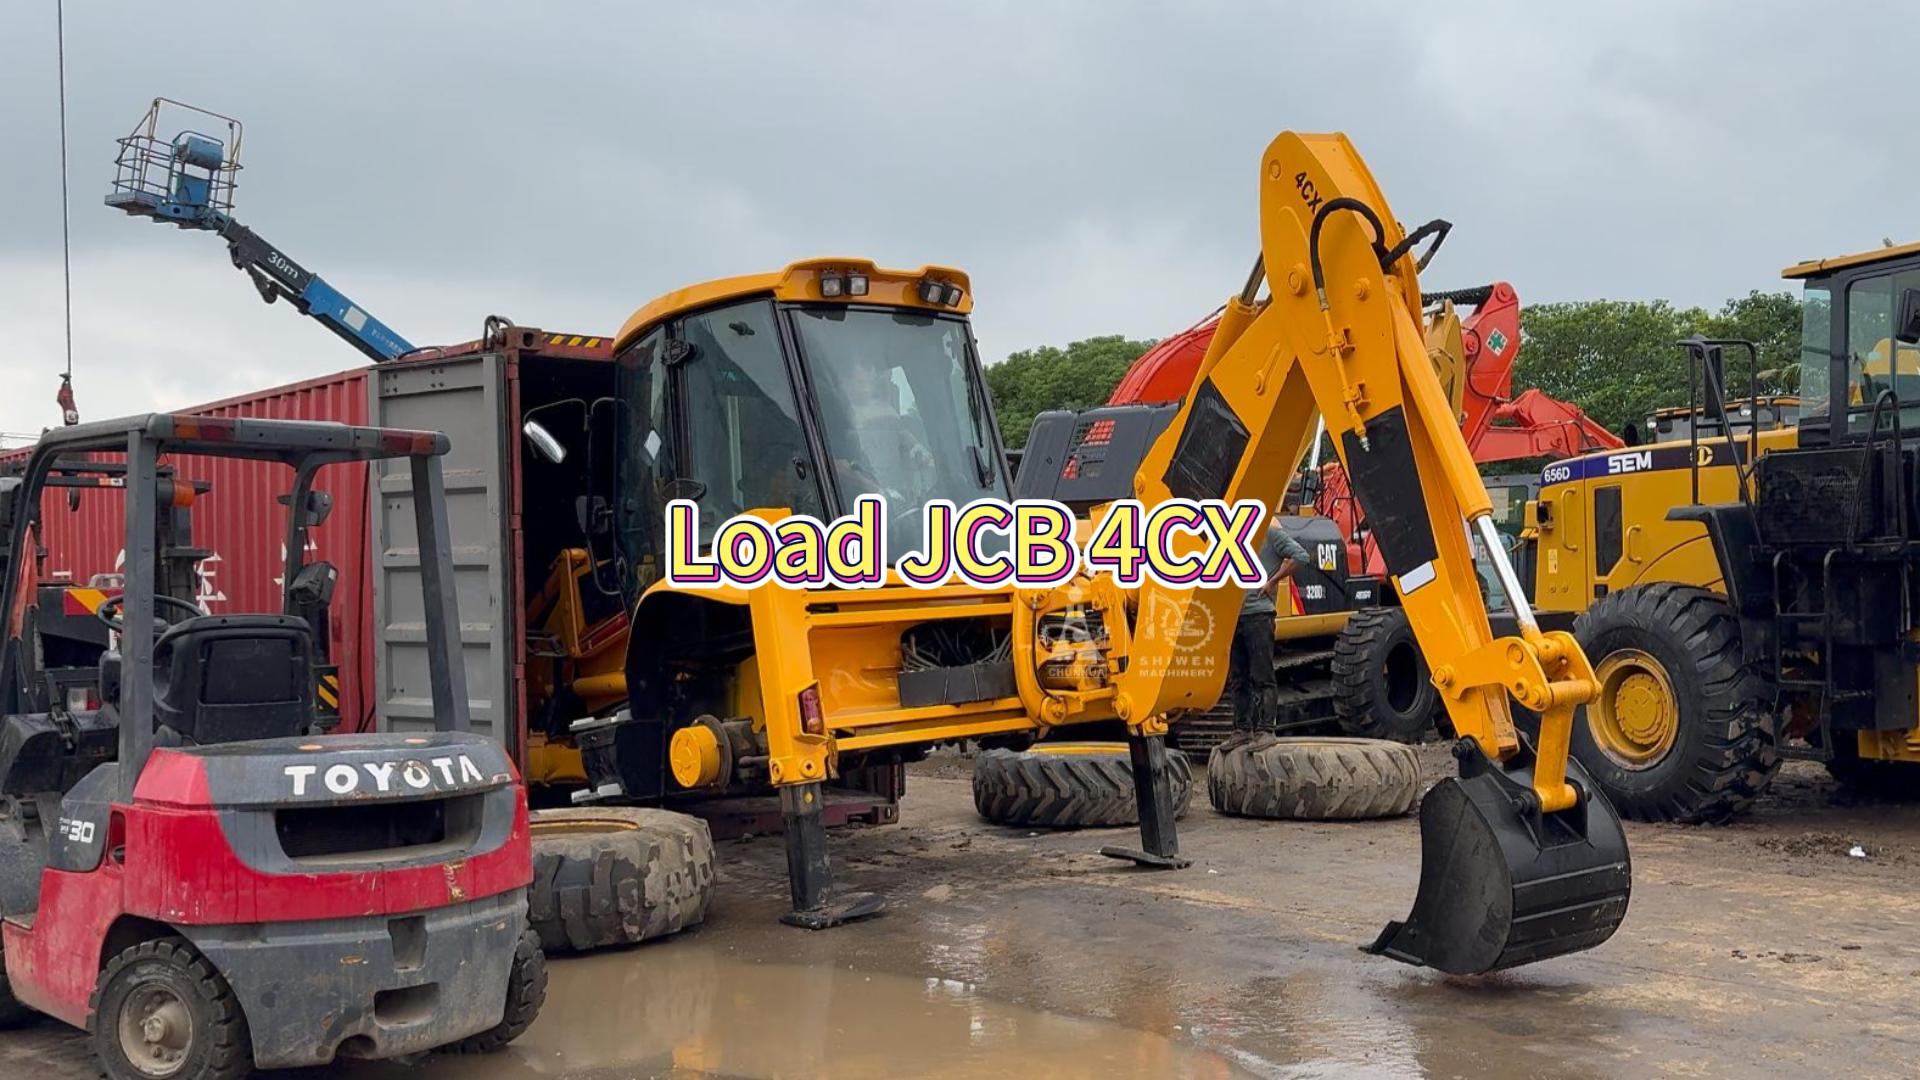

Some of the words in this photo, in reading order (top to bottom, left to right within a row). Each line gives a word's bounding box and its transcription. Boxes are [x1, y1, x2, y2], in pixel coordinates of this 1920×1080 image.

[1295, 171, 1323, 216] 4CX
[268, 251, 299, 279] 30m
[1544, 466, 1571, 482] 656D
[1607, 452, 1653, 474] SEM
[1317, 543, 1338, 571] CAT
[284, 754, 483, 796] TOYOTA
[69, 820, 96, 843] 30
